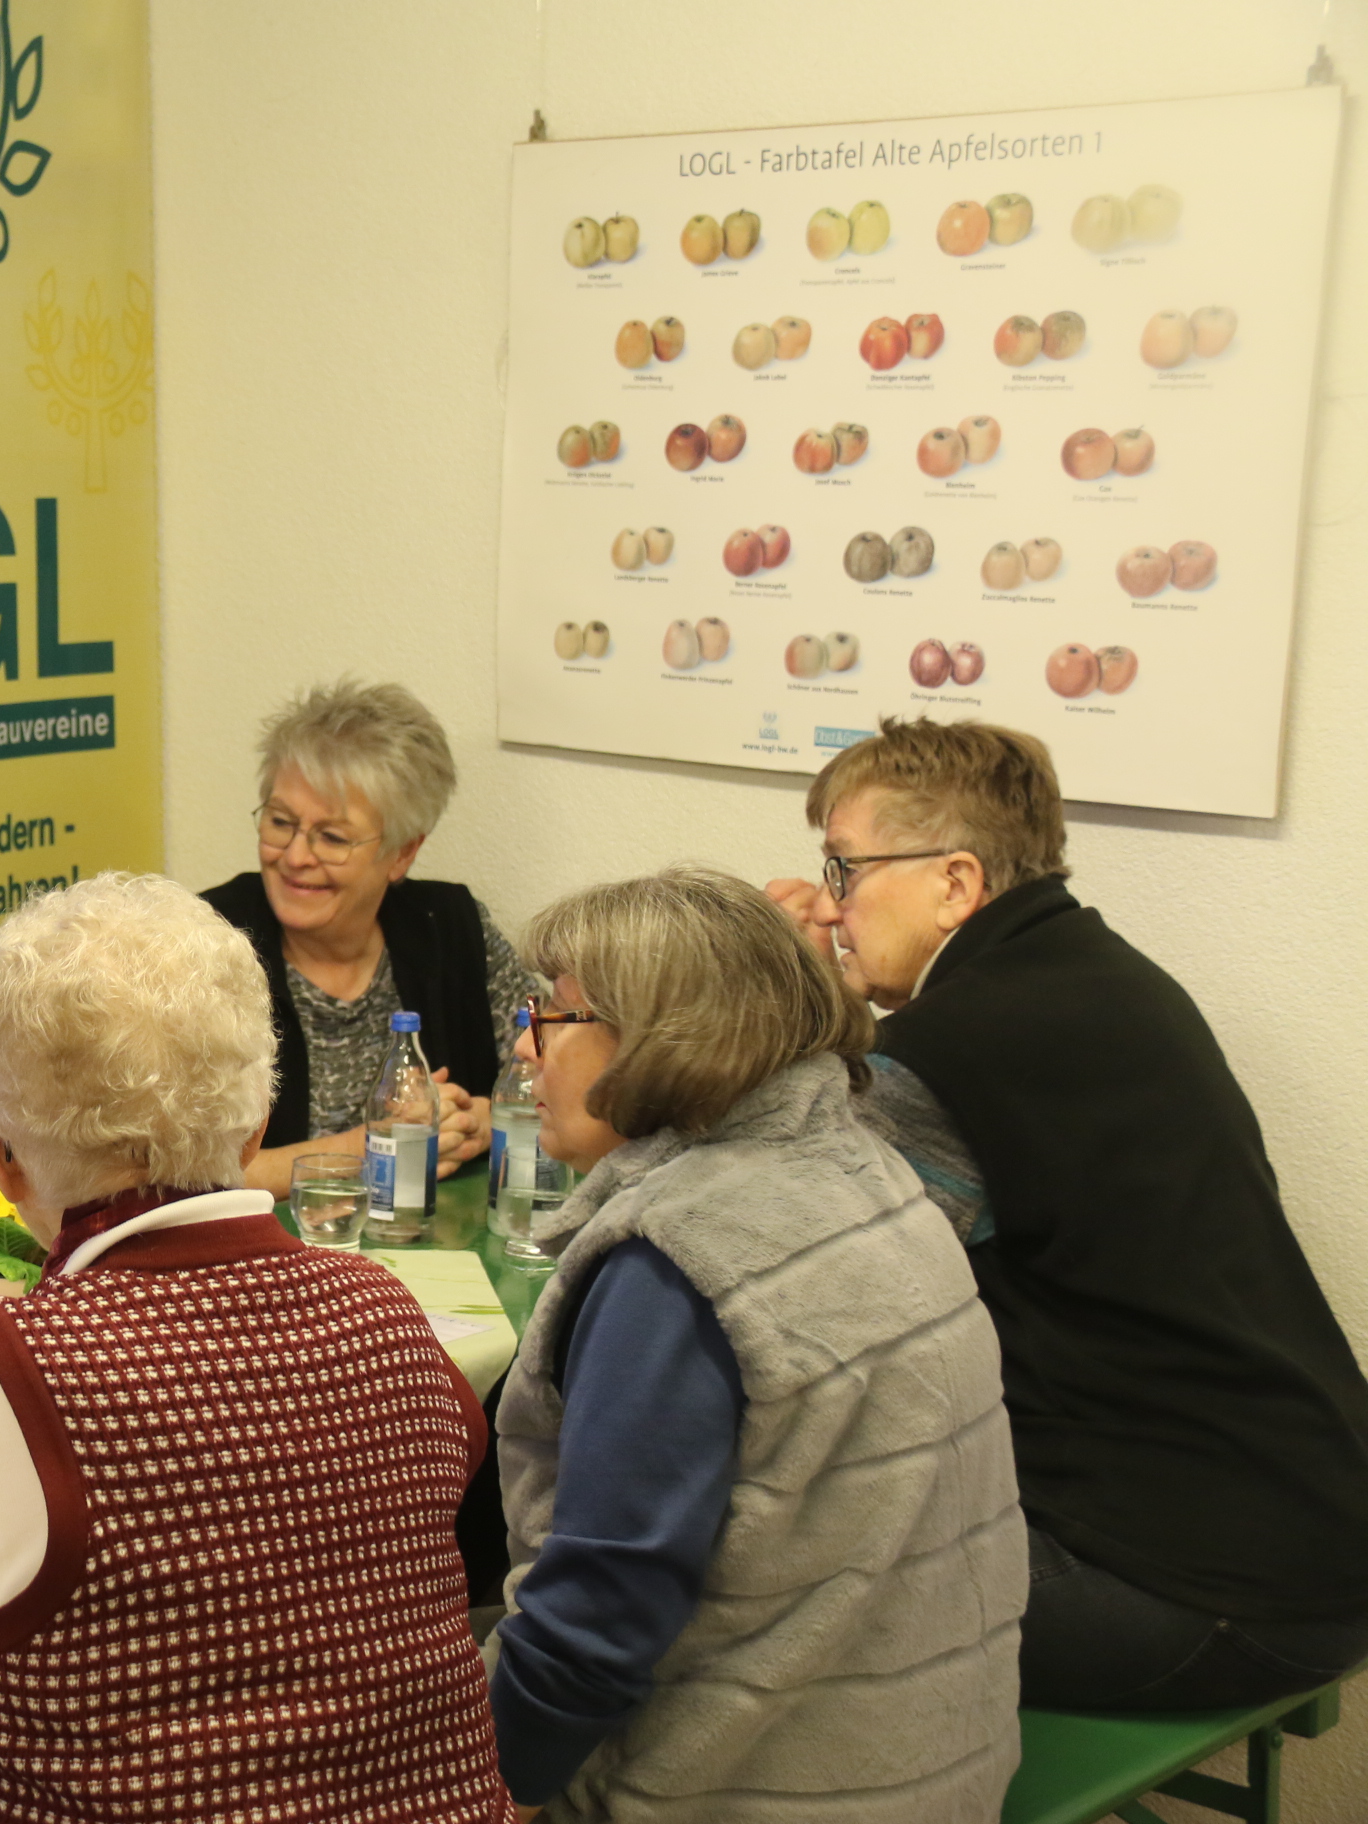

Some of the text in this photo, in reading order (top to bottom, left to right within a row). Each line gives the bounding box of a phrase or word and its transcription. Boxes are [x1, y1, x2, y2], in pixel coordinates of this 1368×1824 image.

[679, 151, 736, 177] LOGL
[760, 141, 864, 173] Farbtafel
[872, 139, 920, 167] Alte
[929, 133, 1083, 170] Apfelsorten
[1094, 132, 1103, 154] 1
